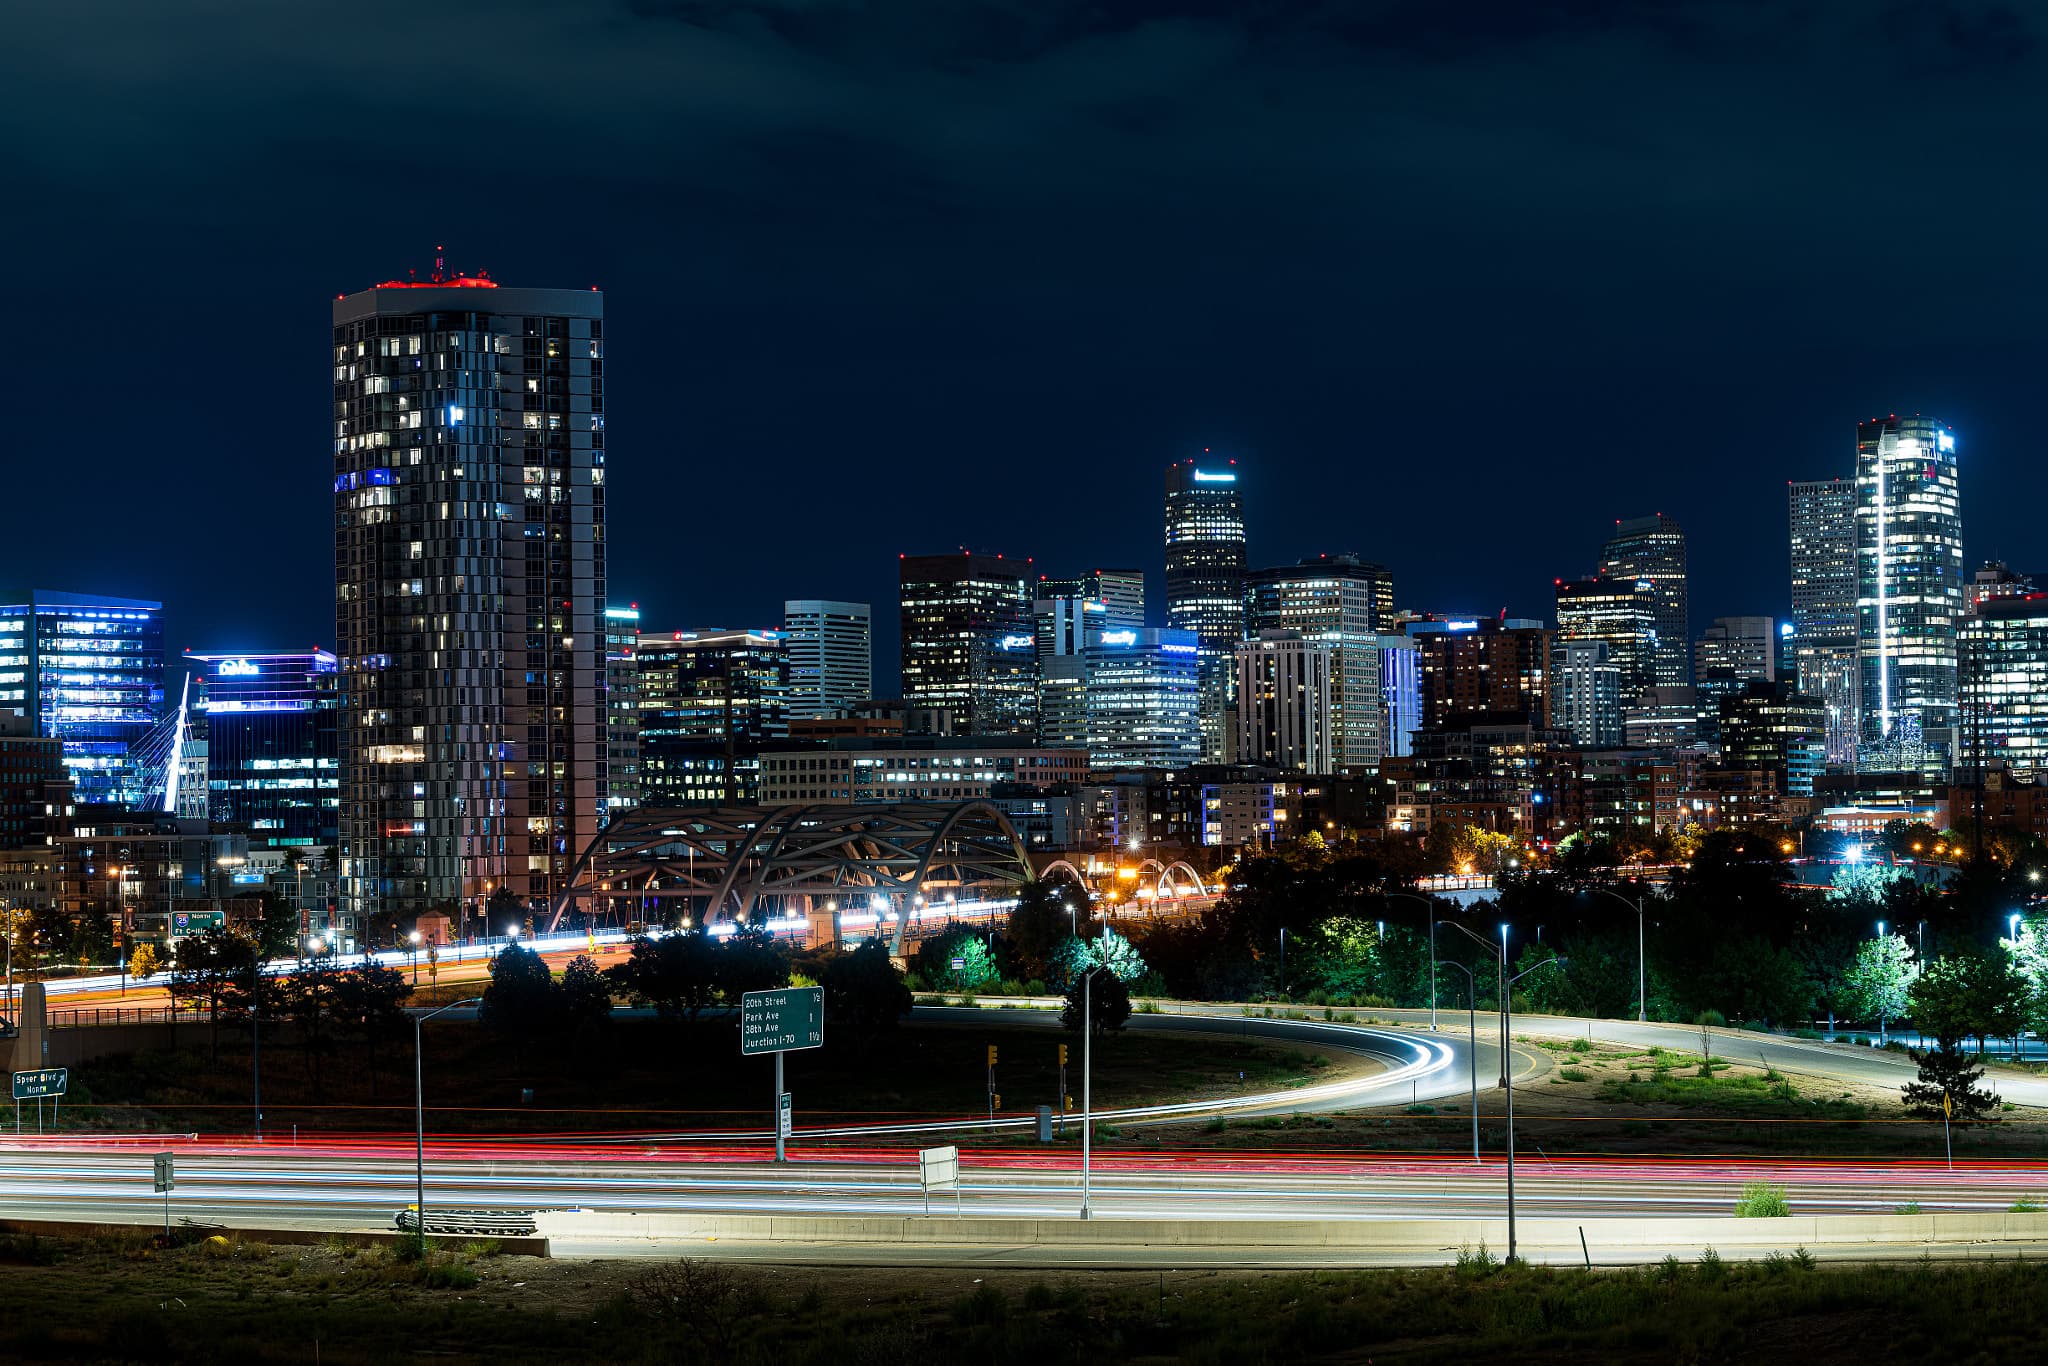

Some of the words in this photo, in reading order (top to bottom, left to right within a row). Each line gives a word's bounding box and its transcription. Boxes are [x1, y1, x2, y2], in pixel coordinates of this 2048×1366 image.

[745, 999, 762, 1008] 20th
[765, 996, 787, 1006] Street
[745, 1012, 763, 1022] Park
[765, 1011, 780, 1021] Ave
[745, 1024, 762, 1034] 38th
[765, 1023, 779, 1033] Ave
[745, 1036, 777, 1048] Junction
[779, 1034, 795, 1045] I-70
[16, 1075, 37, 1085] Speer
[40, 1072, 57, 1082] Blvd
